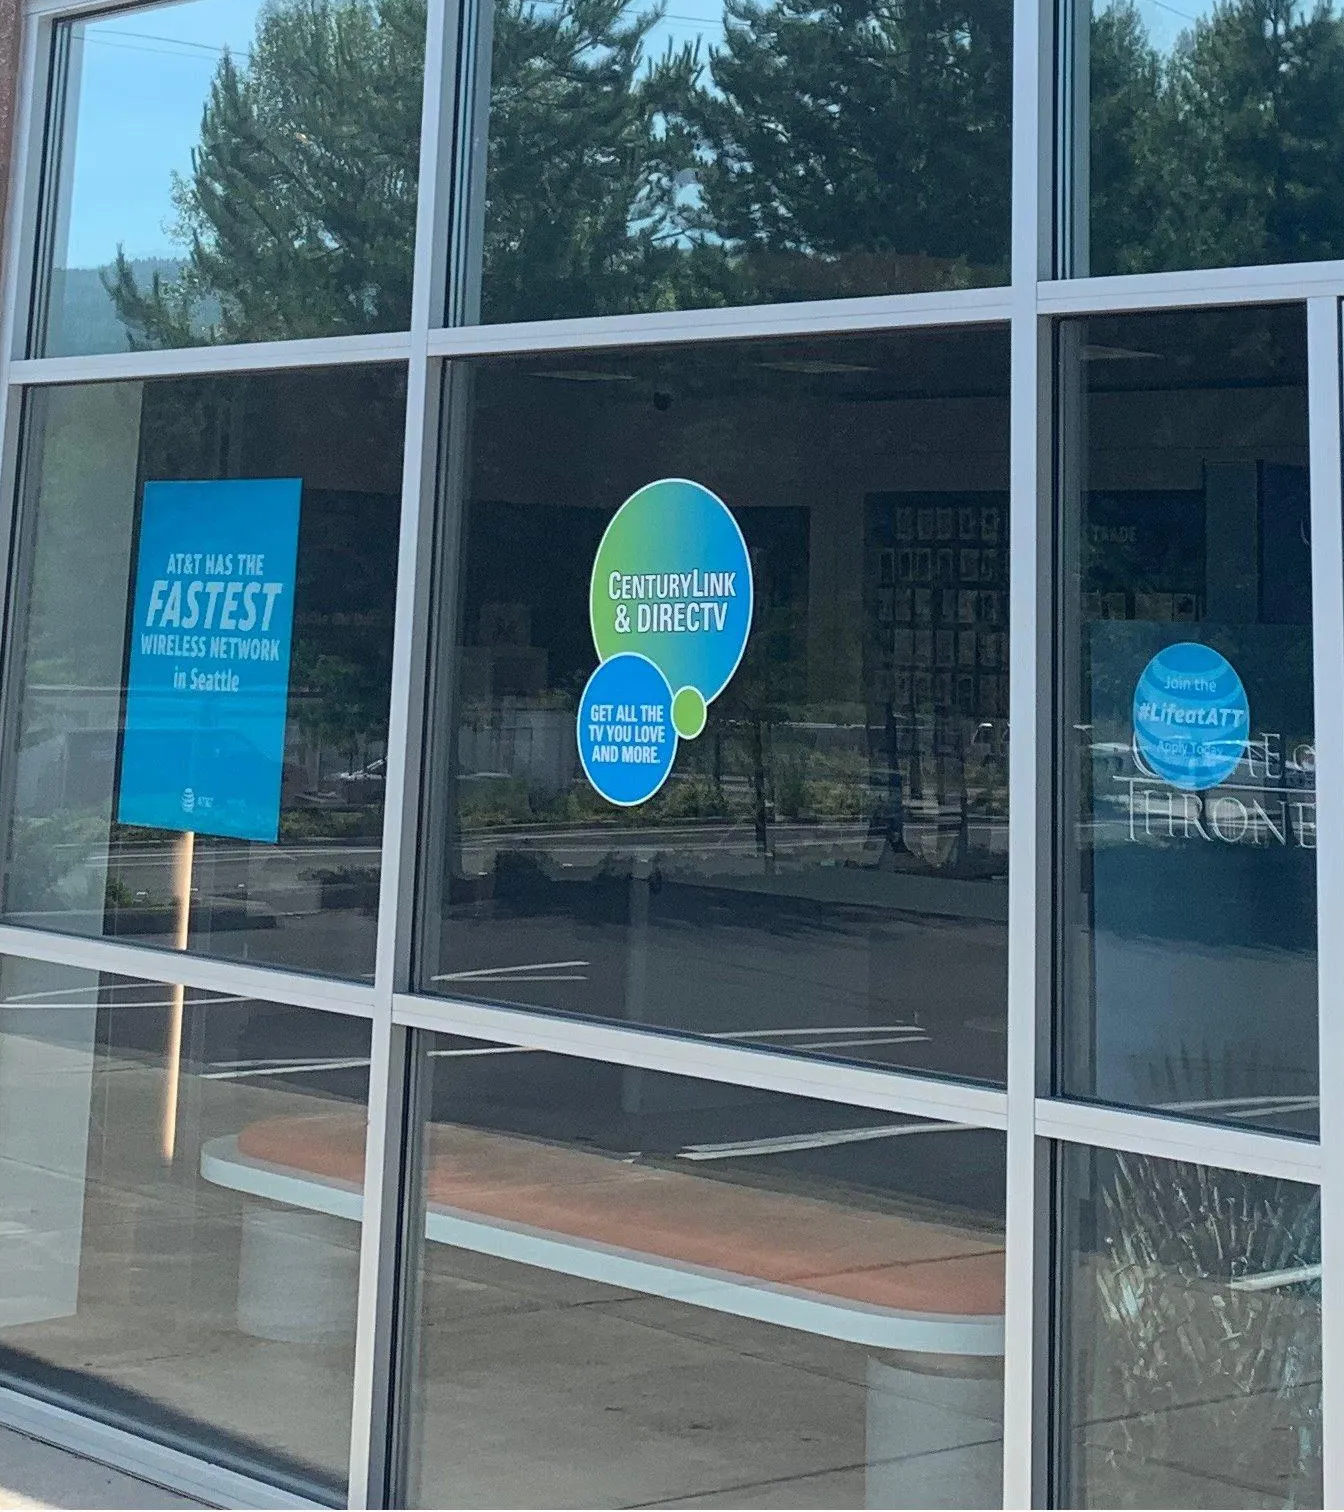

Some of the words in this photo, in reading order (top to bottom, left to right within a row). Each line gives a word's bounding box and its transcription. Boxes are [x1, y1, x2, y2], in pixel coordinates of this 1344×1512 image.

[166, 553, 203, 575] AT&T
[205, 553, 233, 576] HAS
[238, 553, 265, 576] THE
[145, 580, 283, 632] FASTEST
[614, 604, 631, 633] &
[637, 602, 728, 633] DIRECTV
[141, 632, 206, 658] WIRELESS
[209, 636, 281, 661] NETWORK
[173, 666, 187, 690] in
[190, 667, 240, 693] Seattle
[1163, 675, 1191, 690] Join
[1195, 679, 1217, 693] the
[590, 704, 614, 722] GET
[616, 704, 638, 723] ALL
[640, 705, 664, 723] THE
[1137, 701, 1245, 728] #LifeatATT
[588, 725, 607, 742] TV
[607, 726, 632, 743] YOU
[635, 726, 666, 744] LOVE
[592, 745, 619, 763] AND
[622, 746, 661, 764] MORE.
